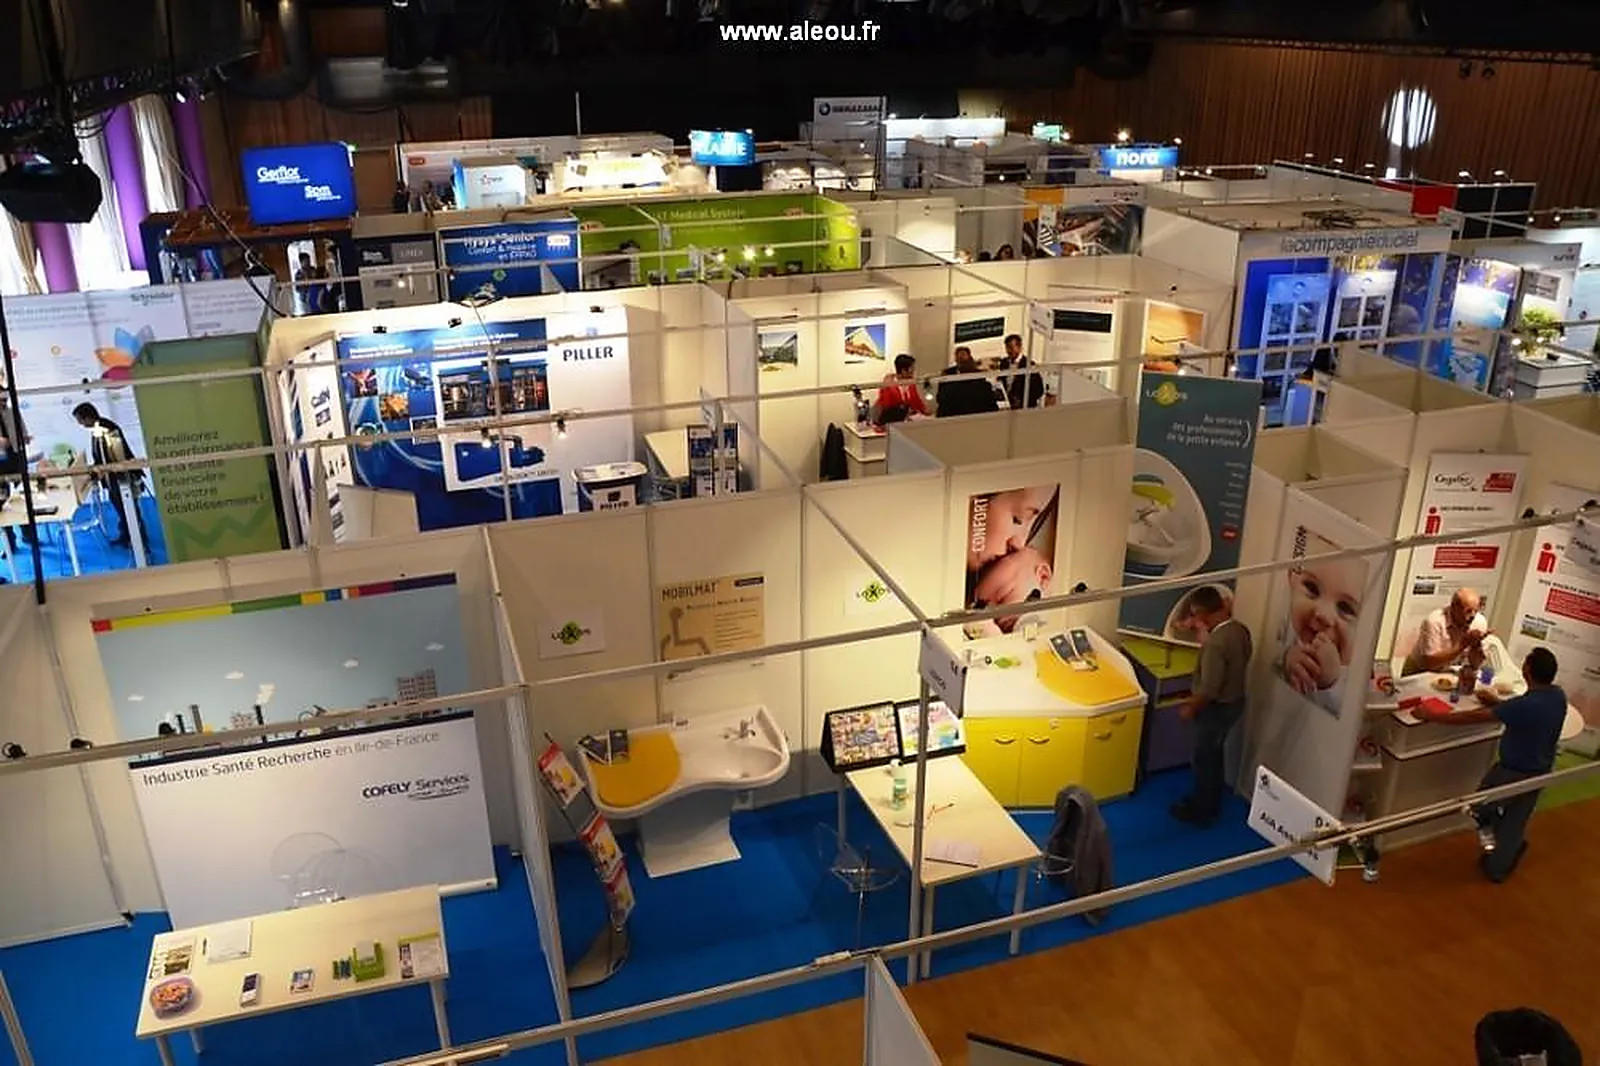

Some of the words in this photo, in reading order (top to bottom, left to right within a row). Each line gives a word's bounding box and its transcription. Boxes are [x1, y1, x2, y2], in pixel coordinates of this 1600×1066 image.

[1117, 151, 1159, 167] nora
[562, 346, 614, 362] PILLER
[972, 498, 989, 553] CONFORT
[143, 766, 210, 787] Industrie
[212, 758, 255, 777] Santé
[257, 746, 333, 769] Recherche
[362, 781, 411, 800] COFELY
